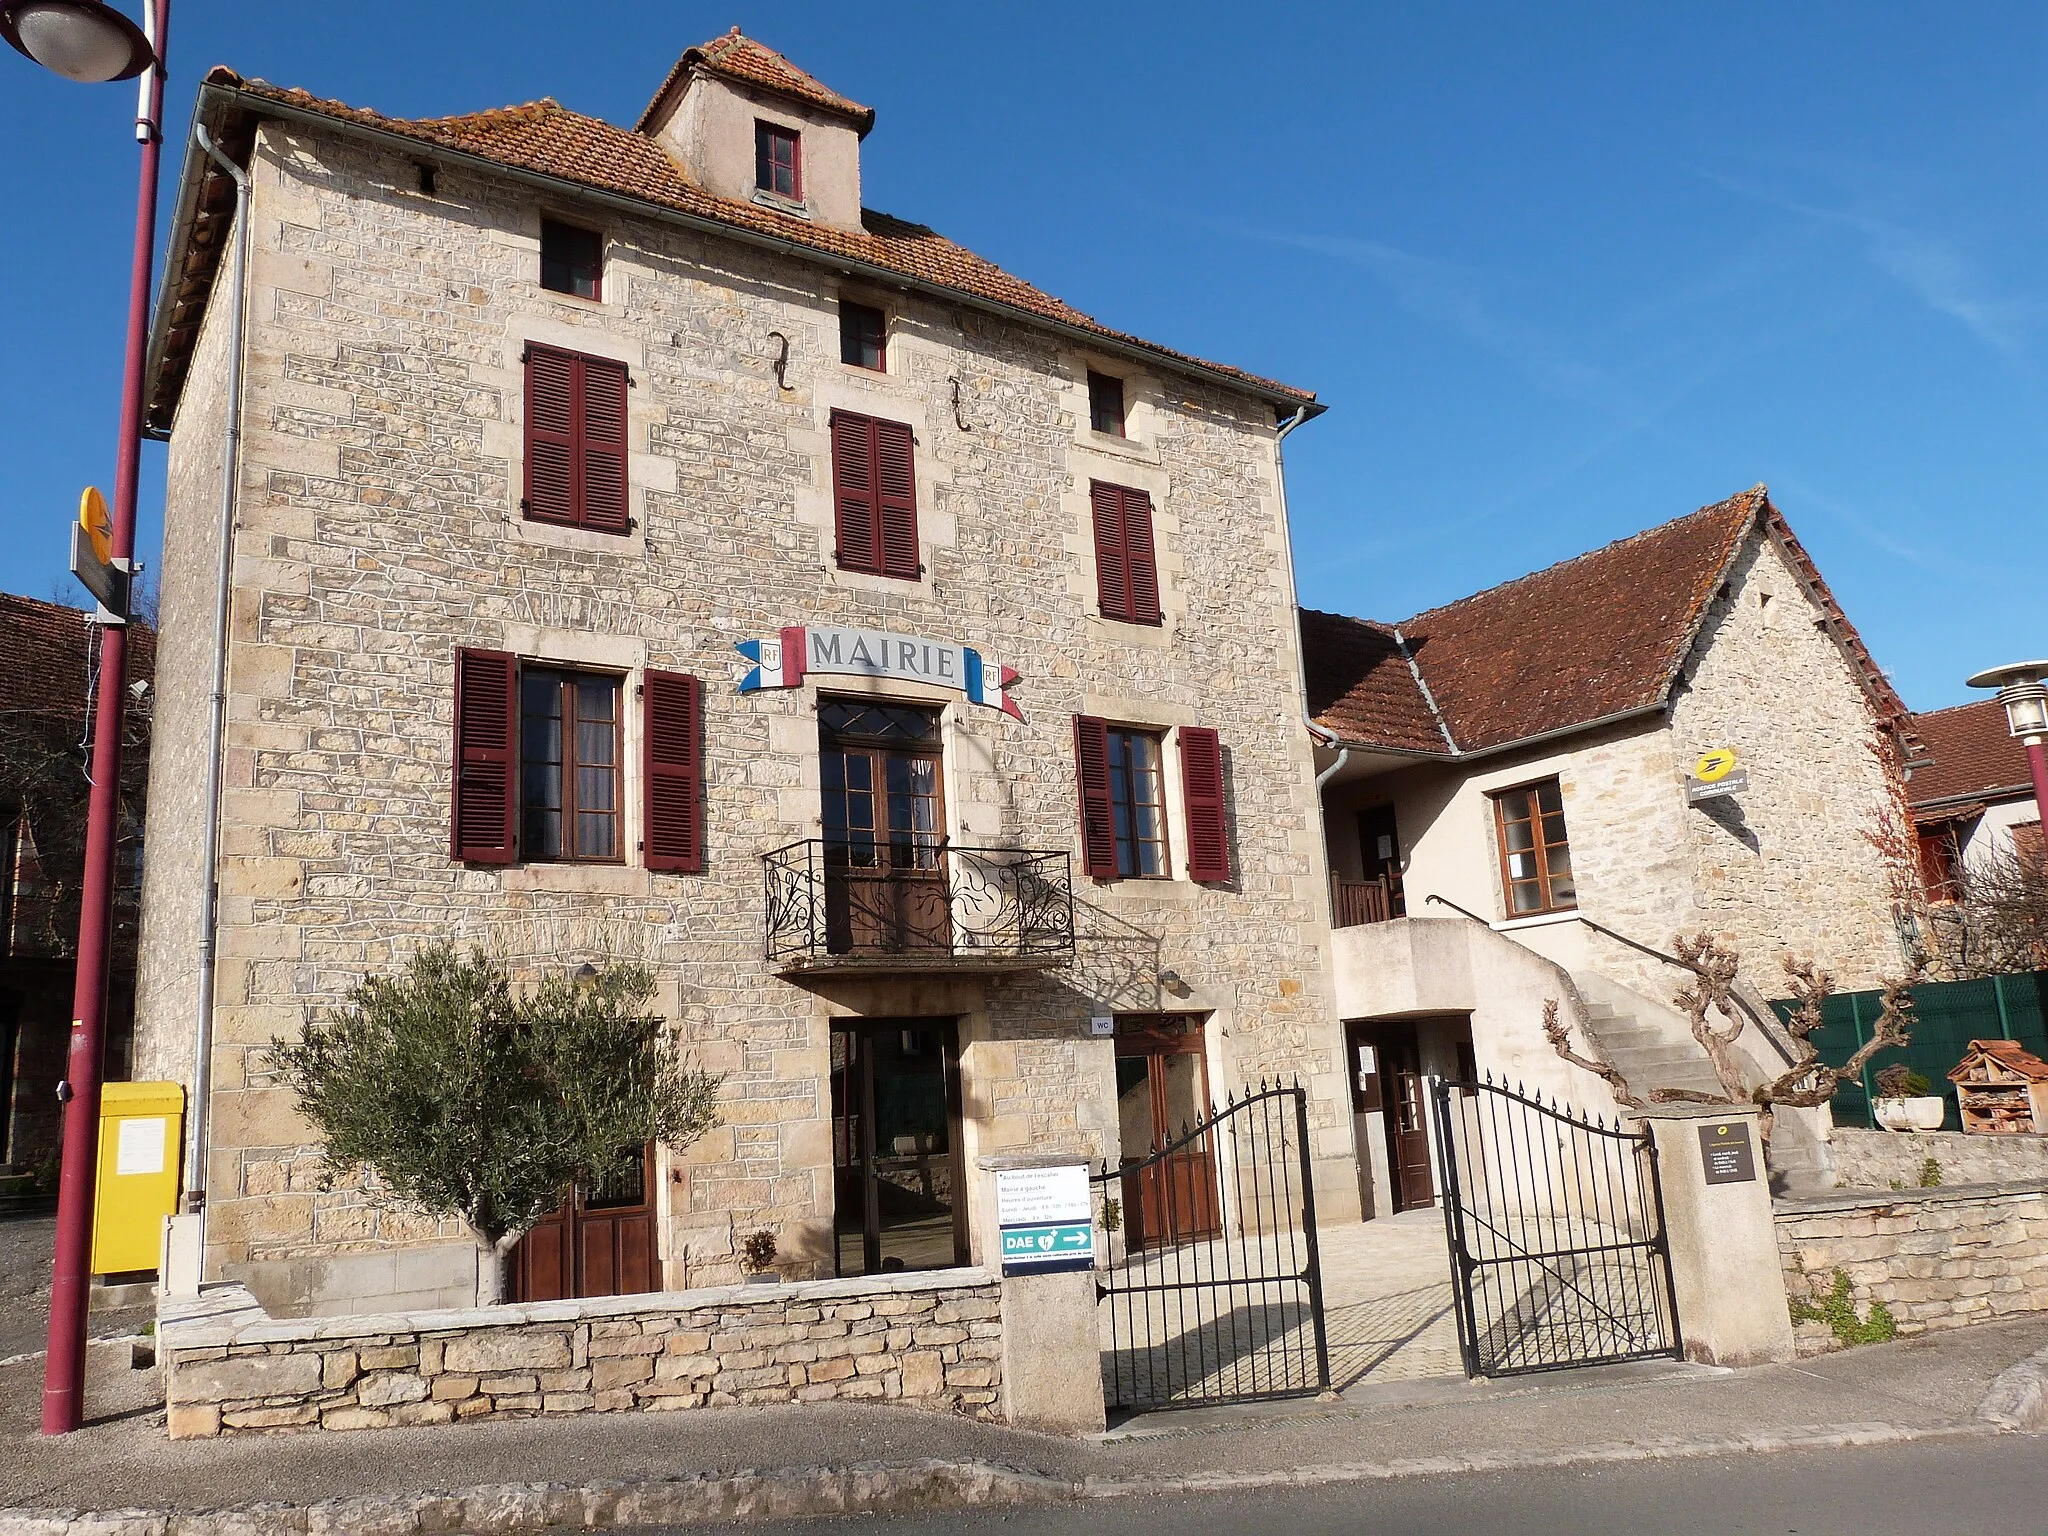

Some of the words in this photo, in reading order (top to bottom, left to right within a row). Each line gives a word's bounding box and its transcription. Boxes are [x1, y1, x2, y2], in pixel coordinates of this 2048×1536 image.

[763, 648, 778, 661] RF
[811, 632, 955, 677] MAIRIE
[985, 669, 998, 682] RF
[1692, 784, 1716, 793] AGENCE
[1717, 778, 1743, 787] POSTALE
[1700, 785, 1737, 796] COMMUNALE
[1006, 1236, 1034, 1249] DAE
